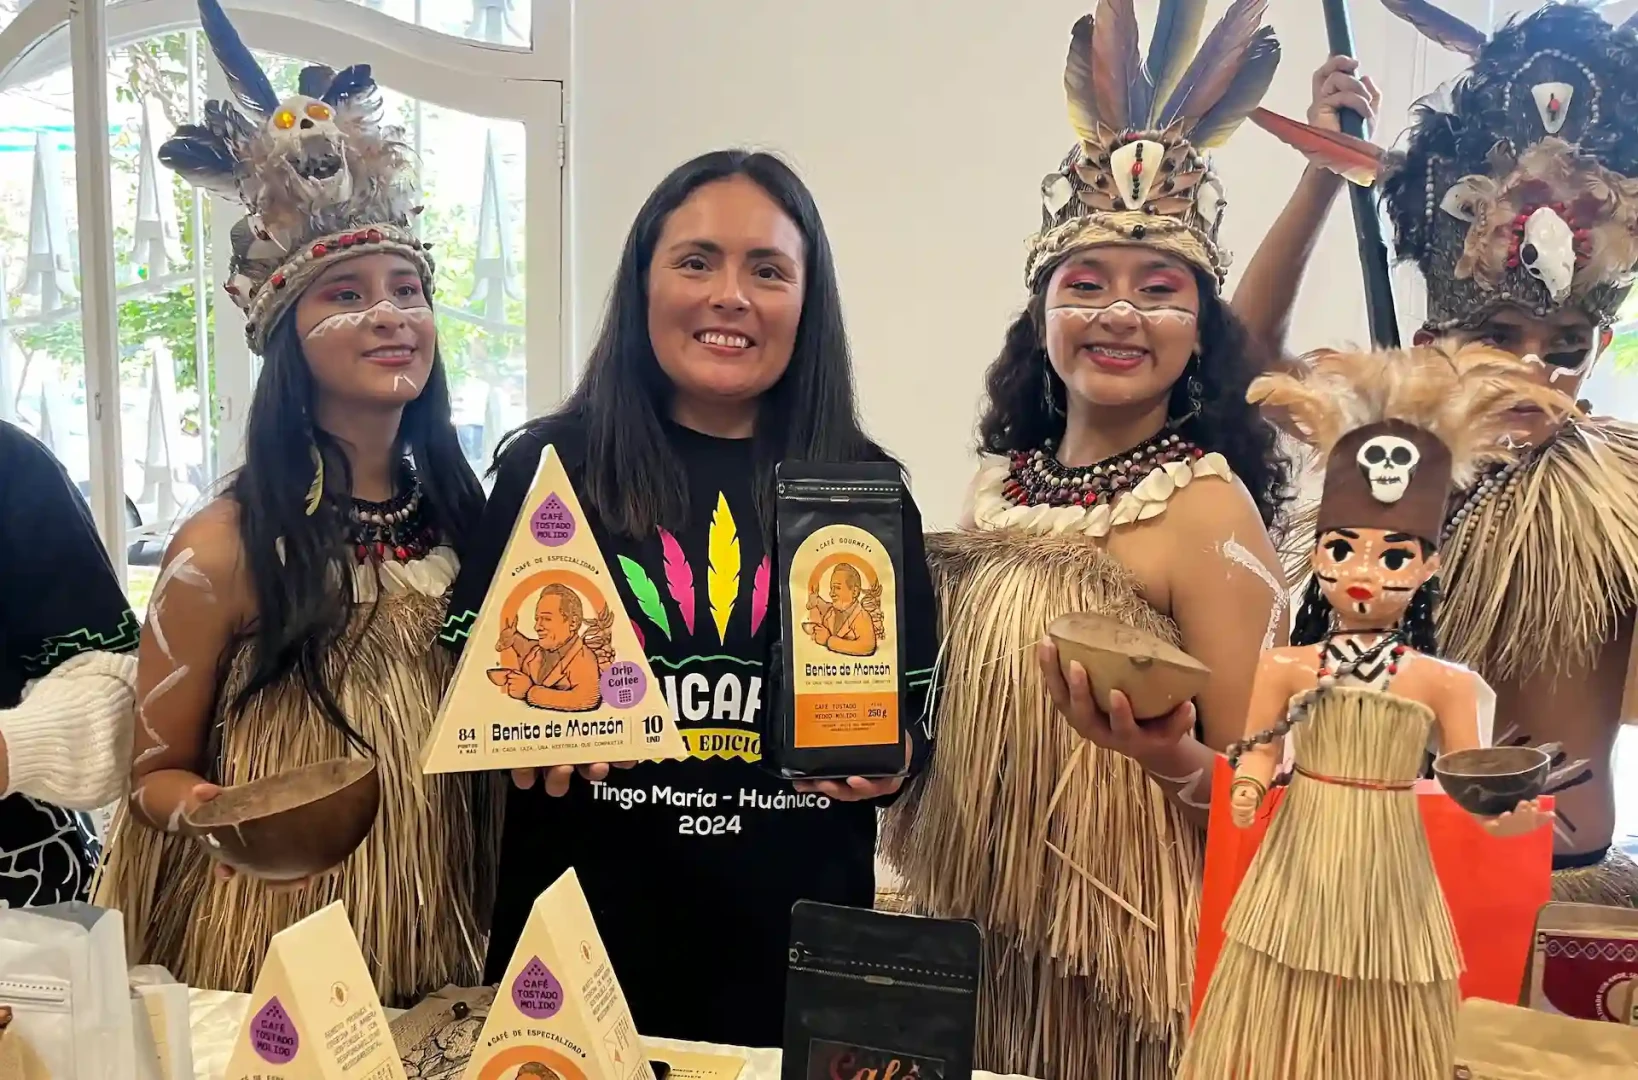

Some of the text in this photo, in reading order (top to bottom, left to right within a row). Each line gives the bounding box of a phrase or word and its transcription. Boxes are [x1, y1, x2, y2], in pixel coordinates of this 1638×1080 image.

[541, 512, 563, 520] CAFÉ
[535, 522, 571, 530] TOSTADO
[839, 537, 869, 550] GOURMET
[547, 555, 596, 572] ESPECIALIDAD
[611, 665, 633, 676] Drip
[805, 661, 891, 677] Benito de Monzón
[608, 676, 639, 688] Coffee
[867, 708, 881, 718] 250
[492, 716, 624, 741] Benito de Monzón
[641, 715, 664, 735] 10
[458, 728, 476, 741] 84
[590, 780, 647, 810] Tingo
[651, 784, 717, 809] María
[738, 787, 831, 811] Huánuco
[678, 815, 742, 836] 2024
[523, 978, 549, 989] CAFÉ
[517, 989, 559, 1000] TOSTADO
[520, 1000, 556, 1010] MOLIDO
[261, 1018, 286, 1033] CAFÉ
[255, 1029, 295, 1046] TOSTADO
[491, 1029, 582, 1055] CAFÉ DE ESPECIALIDAD
[256, 1041, 291, 1057] MOLIDO
